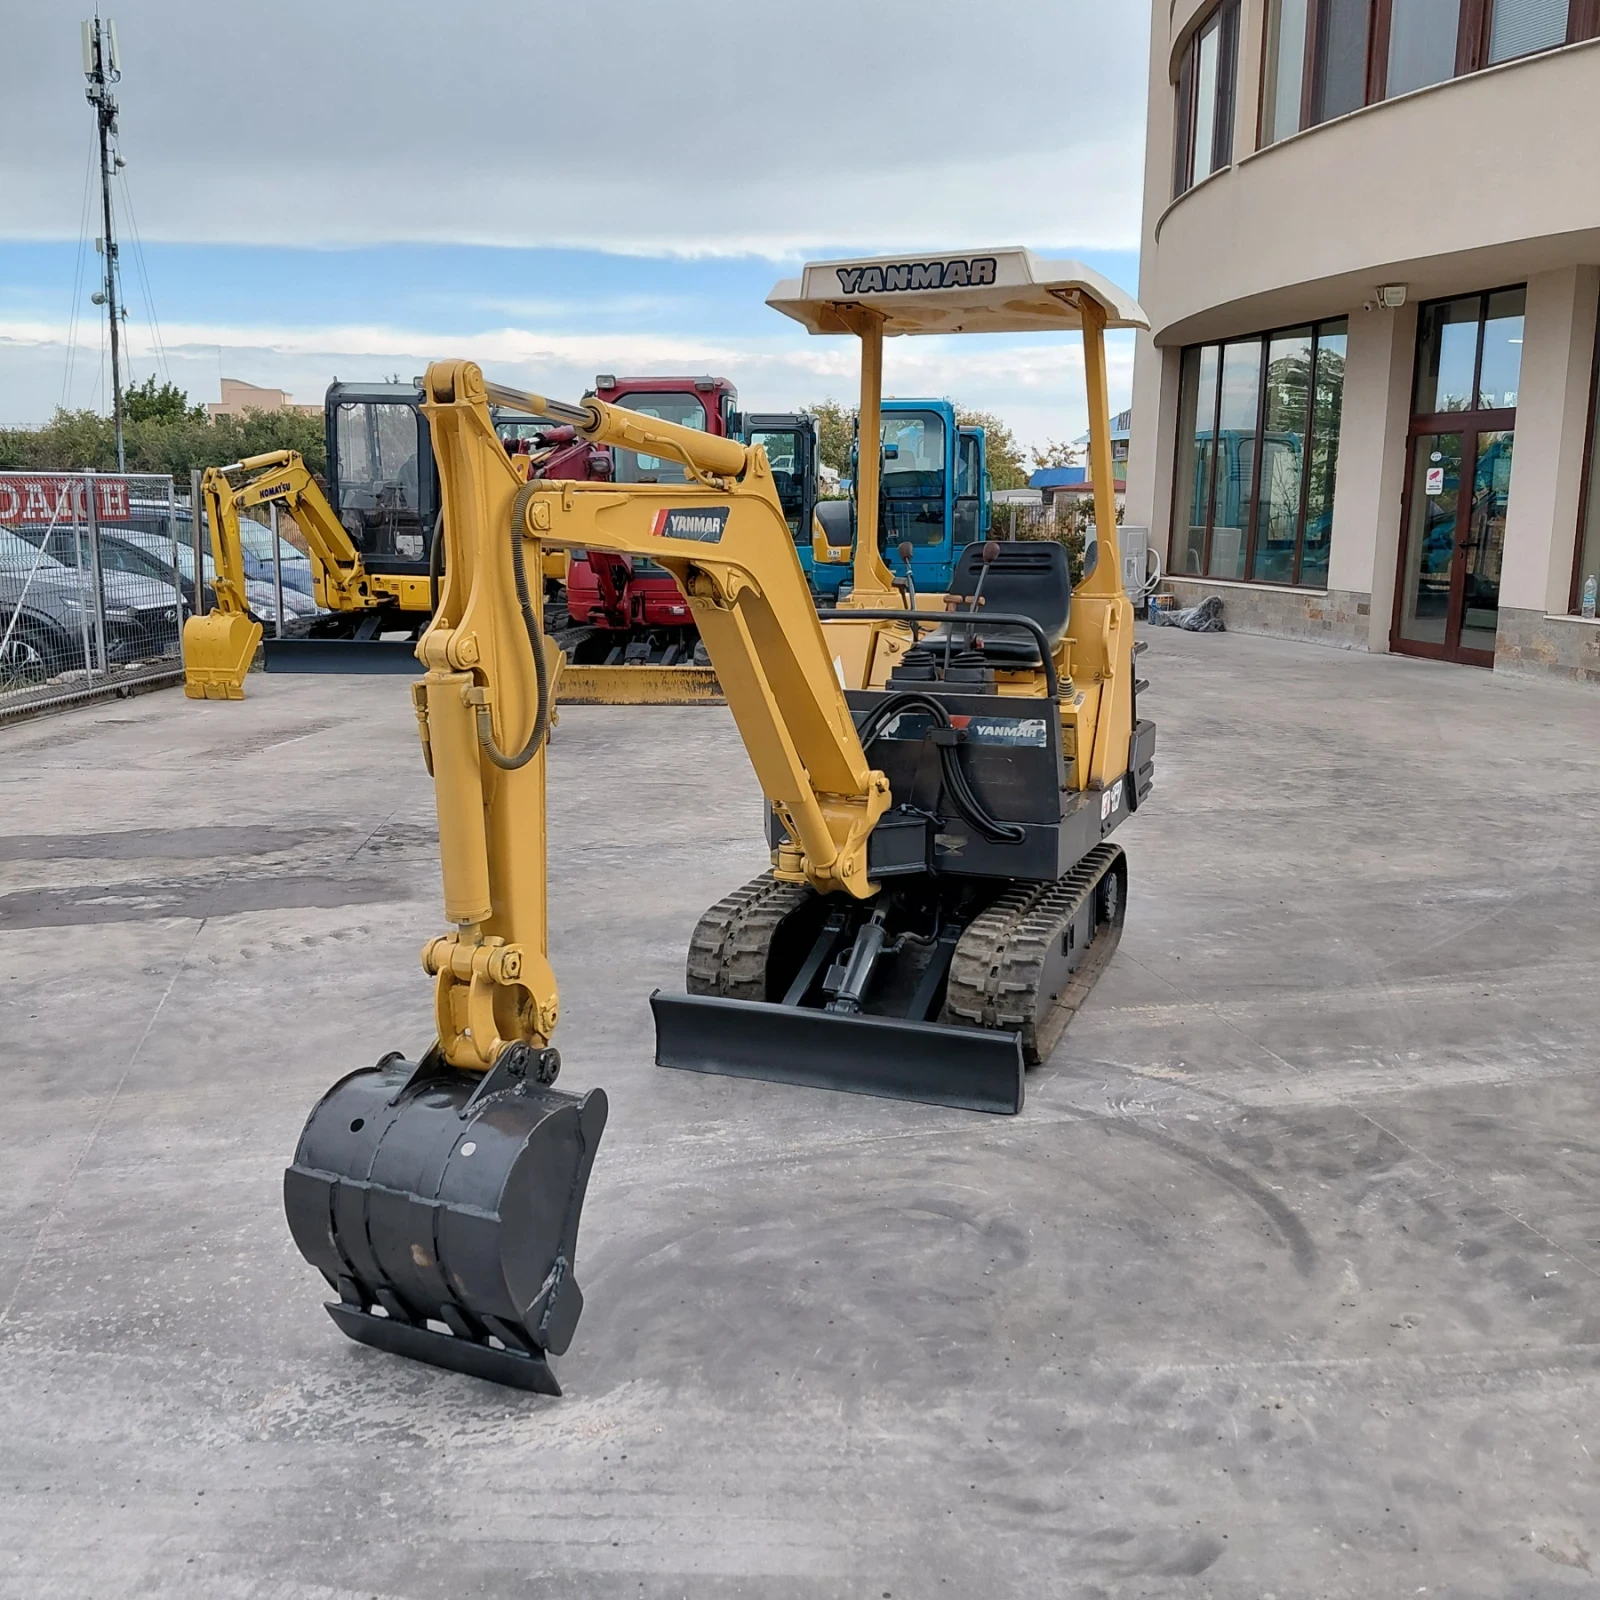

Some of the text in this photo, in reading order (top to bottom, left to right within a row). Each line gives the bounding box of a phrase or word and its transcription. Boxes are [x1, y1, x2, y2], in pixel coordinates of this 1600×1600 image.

[836, 258, 997, 294] YANMAR
[259, 482, 291, 498] KOMATSU
[670, 515, 721, 533] YANMAR
[976, 725, 1038, 738] YANMAR
